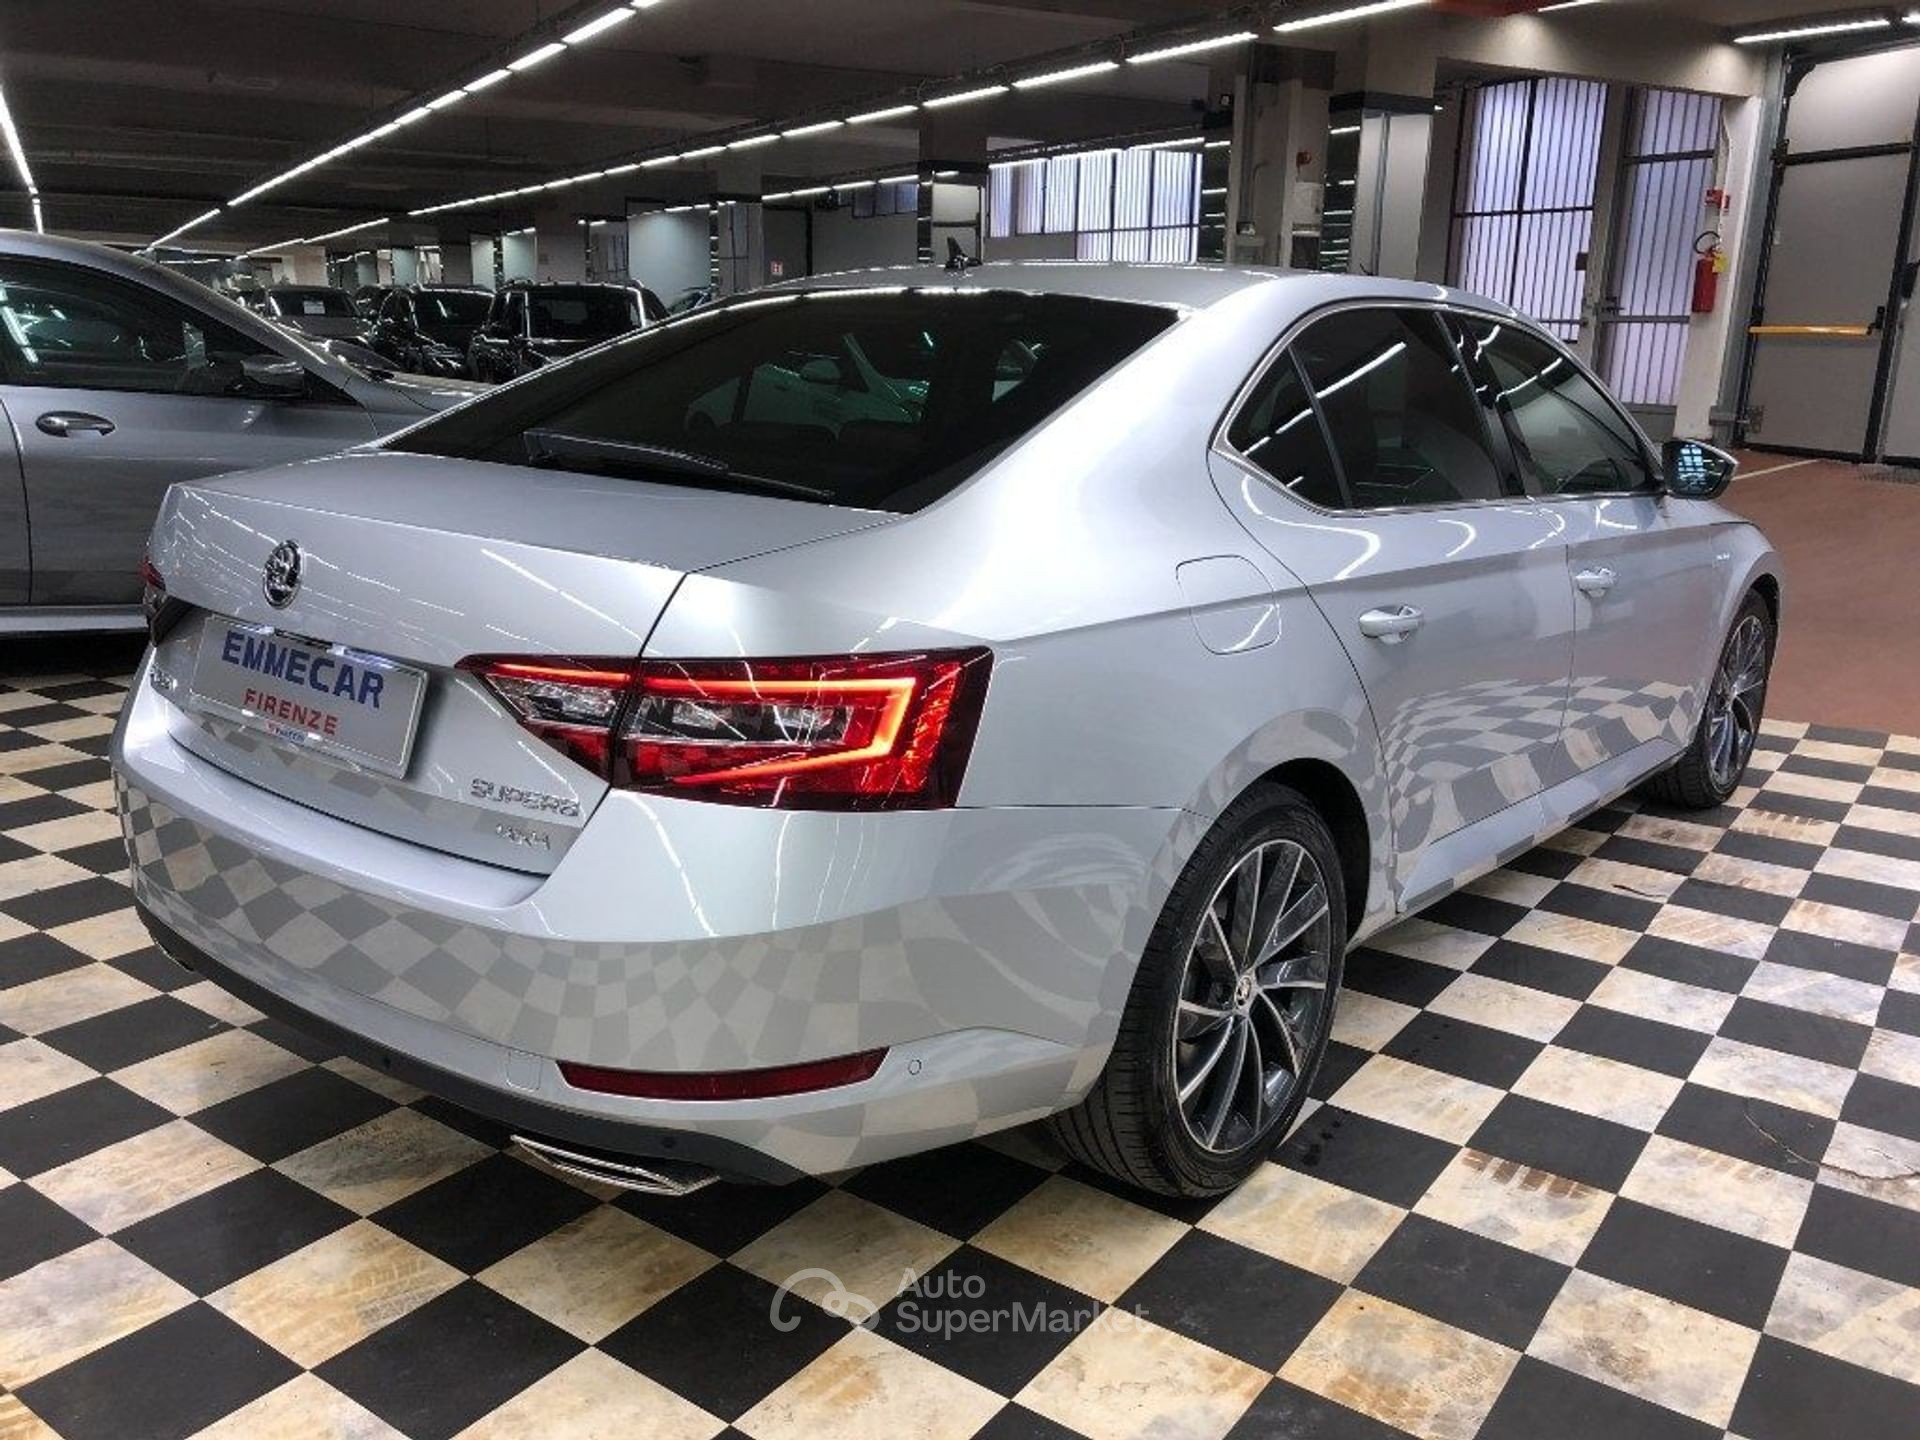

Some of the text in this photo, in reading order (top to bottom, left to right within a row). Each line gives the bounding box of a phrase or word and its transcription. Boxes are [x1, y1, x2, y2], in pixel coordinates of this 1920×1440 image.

[221, 630, 385, 709] EMMECAR
[242, 688, 339, 735] FIRENZE
[470, 777, 580, 817] SUPERB
